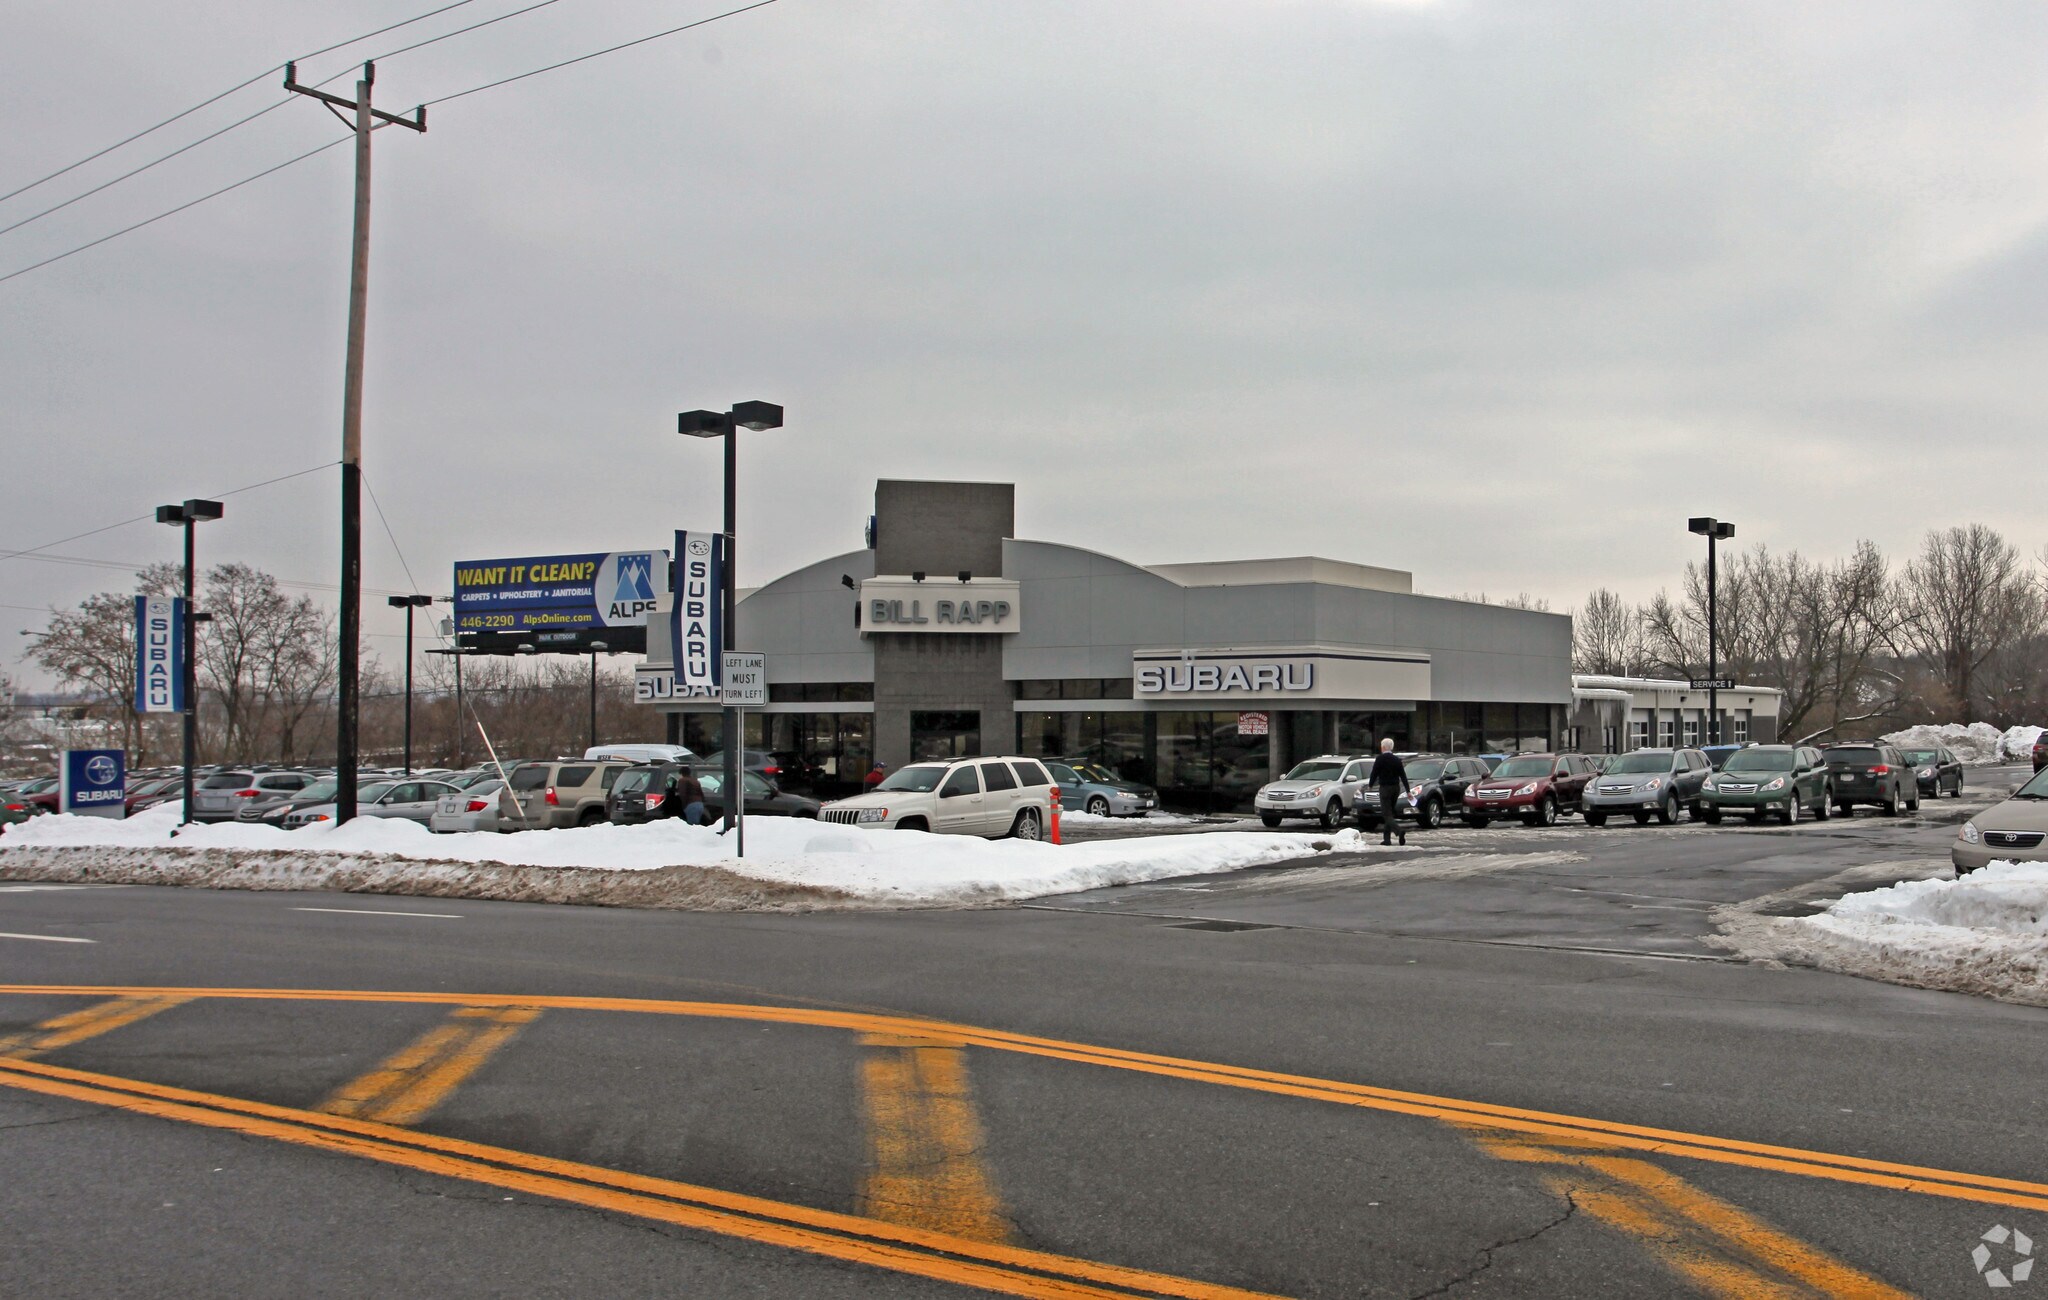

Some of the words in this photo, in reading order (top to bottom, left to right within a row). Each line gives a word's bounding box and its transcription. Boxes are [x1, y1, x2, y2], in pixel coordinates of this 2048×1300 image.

[457, 567, 507, 586] WANT
[510, 566, 525, 584] IT
[529, 561, 595, 583] CLEAN?
[461, 592, 490, 601] CARPETS
[499, 589, 543, 600] UPHOLSTERY
[551, 587, 592, 597] JANITORIAL
[871, 599, 928, 624] BILL
[937, 600, 1011, 625] RAPP
[460, 614, 515, 628] 446-2290
[523, 613, 592, 626] AlpsOnline.com
[686, 561, 706, 678] SUBARU
[150, 618, 168, 705] SUBARU
[725, 659, 742, 668] LEFT
[745, 659, 763, 668] LANE
[732, 673, 756, 684] MUST
[1137, 662, 1314, 693] SUBARU
[1692, 680, 1726, 688] SERVICE
[725, 689, 742, 698] TURN
[745, 689, 763, 698] LEFT
[76, 789, 123, 802] SUBARU
